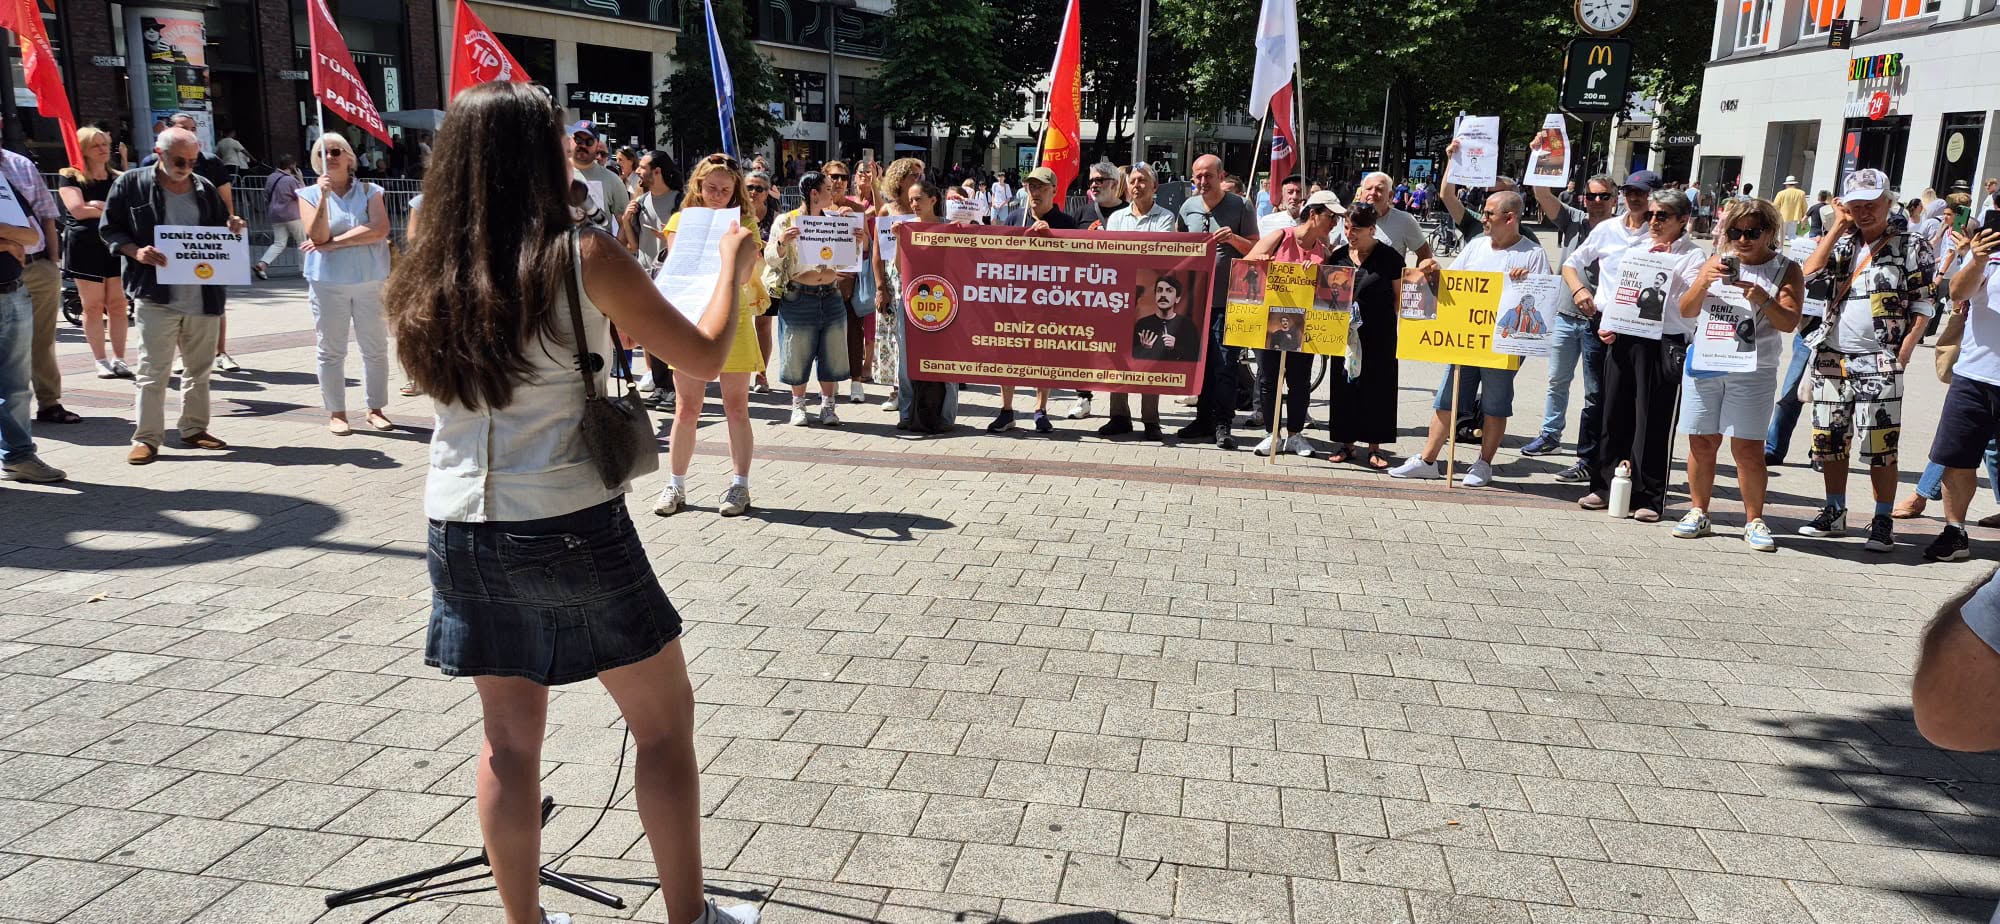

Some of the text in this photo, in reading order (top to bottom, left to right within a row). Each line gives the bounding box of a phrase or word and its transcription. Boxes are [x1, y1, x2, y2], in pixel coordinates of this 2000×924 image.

[1848, 53, 1901, 80] BUTLERS
[160, 231, 242, 242] DENİZ GÖKTAŞ
[914, 233, 1204, 254] Finger weg von der Kunst- und Meinungsfreiheit!
[976, 262, 1117, 285] FREIHEIT FÜR
[917, 302, 943, 312] DIDF
[963, 283, 1027, 304] DENİZ
[1032, 285, 1130, 313] GÖKTAŞ!
[994, 321, 1094, 339] DENİZ GÖKTAŞ
[971, 335, 1117, 353] SERBEST BIRAKILSIN!
[1419, 331, 1490, 349] ADALET
[923, 361, 956, 370] Sanat
[975, 362, 1003, 374] ifade
[1006, 363, 1093, 379] özgürlüğünden
[1096, 370, 1145, 382] ellerinizi
[1147, 373, 1183, 384] çekin!
